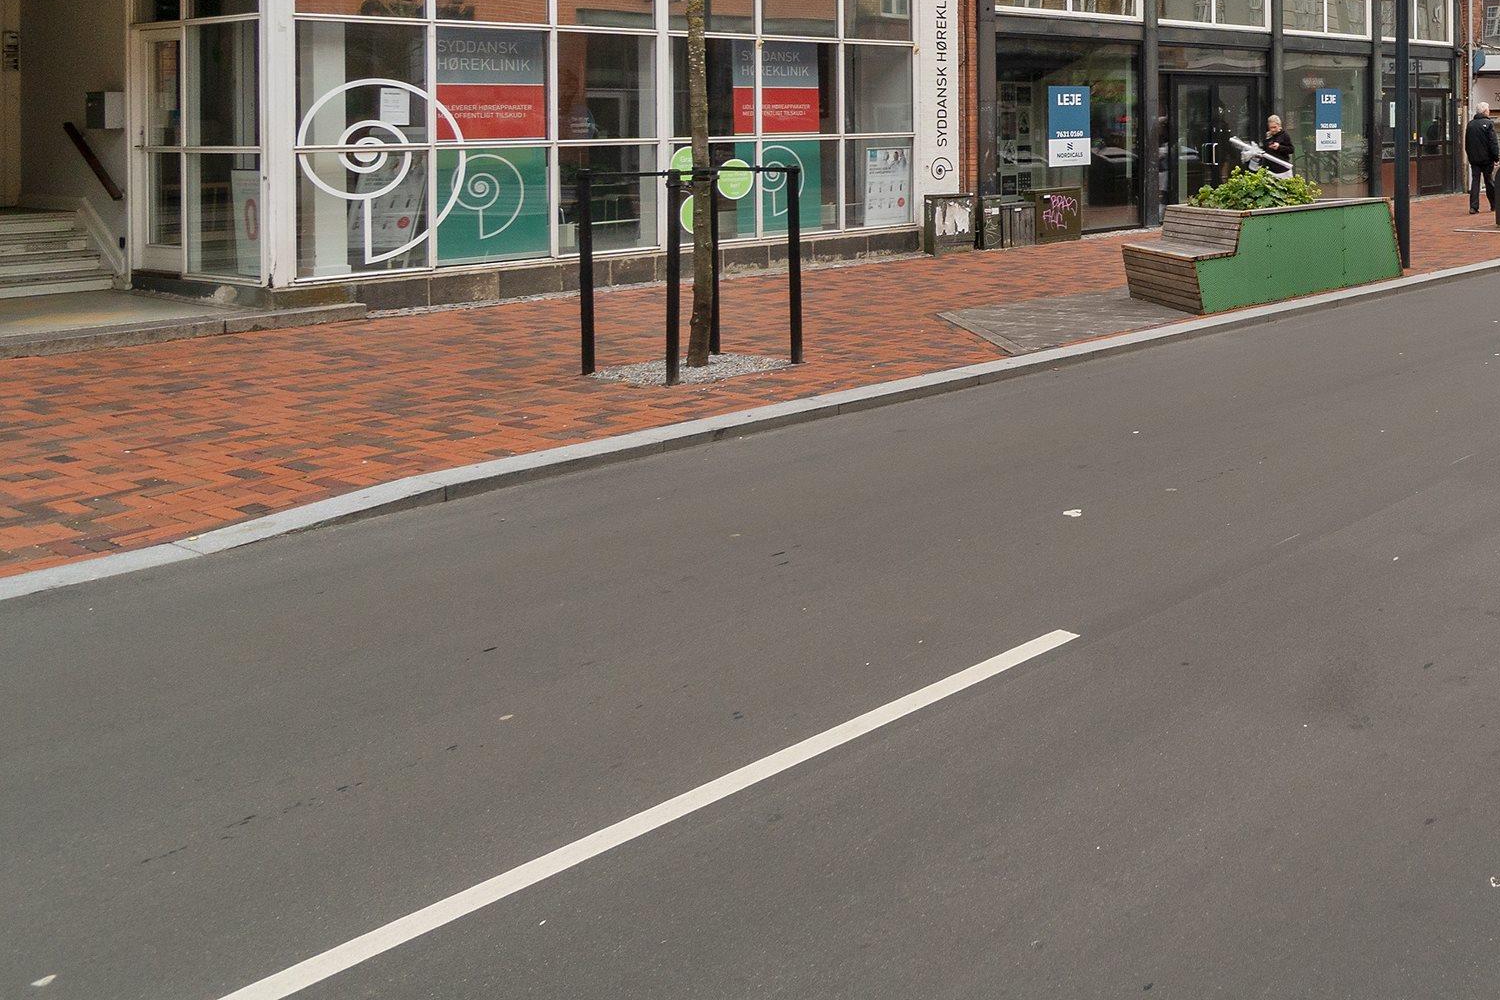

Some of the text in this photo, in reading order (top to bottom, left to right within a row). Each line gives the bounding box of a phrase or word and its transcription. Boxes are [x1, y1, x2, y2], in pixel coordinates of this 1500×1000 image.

[437, 40, 519, 54] SYDDANSK
[436, 57, 531, 71] HØREKLINIK
[1057, 93, 1082, 106] LEJE
[1321, 94, 1337, 104] LEJE
[936, 66, 948, 147] SYDDANSK
